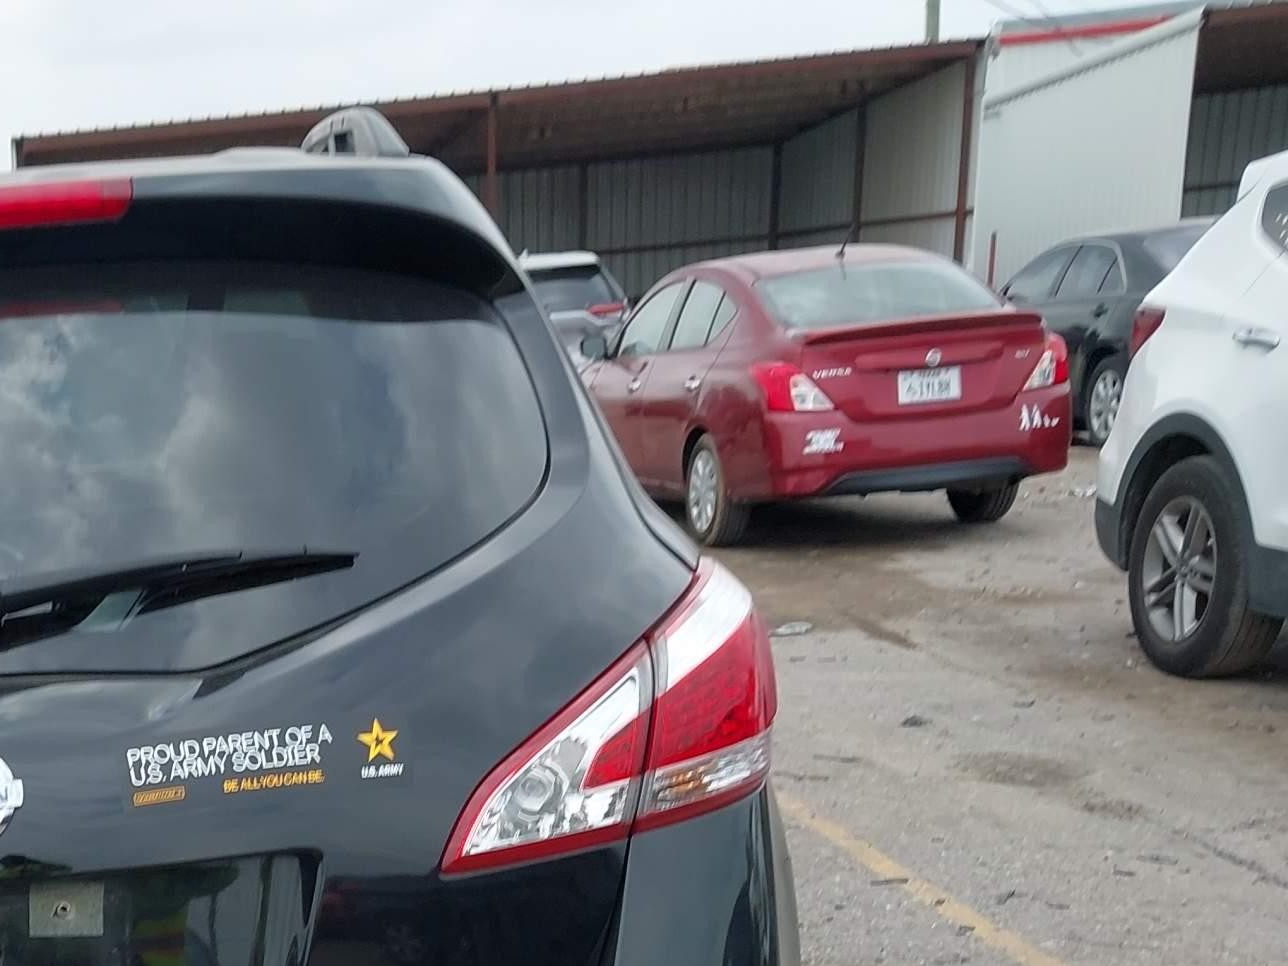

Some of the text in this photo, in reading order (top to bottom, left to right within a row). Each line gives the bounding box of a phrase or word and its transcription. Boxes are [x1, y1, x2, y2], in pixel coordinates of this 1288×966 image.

[127, 723, 332, 769] PROUD PARENT OF A
[170, 752, 229, 782] ARMY
[232, 743, 321, 772] SOLDIER
[378, 763, 404, 777] ARMY
